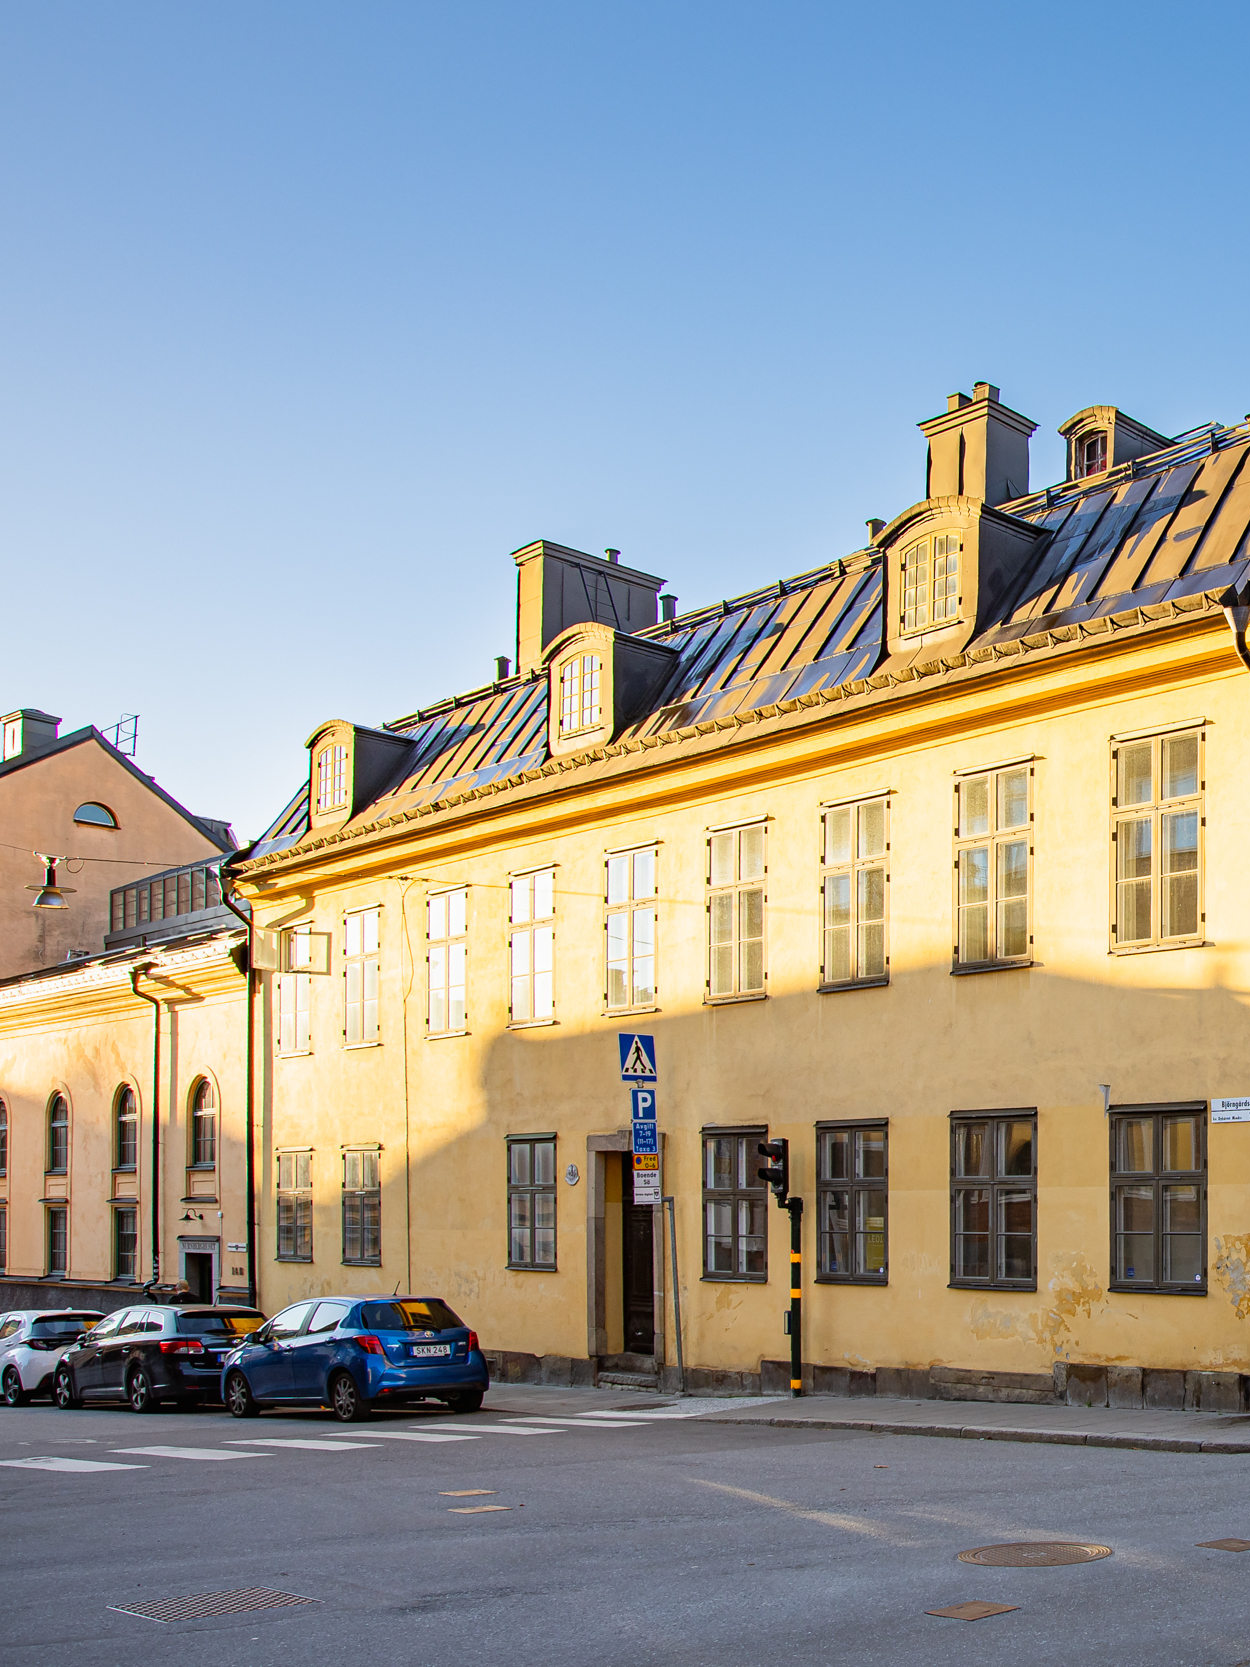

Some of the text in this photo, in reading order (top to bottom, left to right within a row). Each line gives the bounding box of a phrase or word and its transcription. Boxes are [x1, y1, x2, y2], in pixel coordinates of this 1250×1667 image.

[637, 1092, 652, 1118] P
[868, 1235, 884, 1243] LEDI
[416, 1345, 448, 1355] SKN 248
